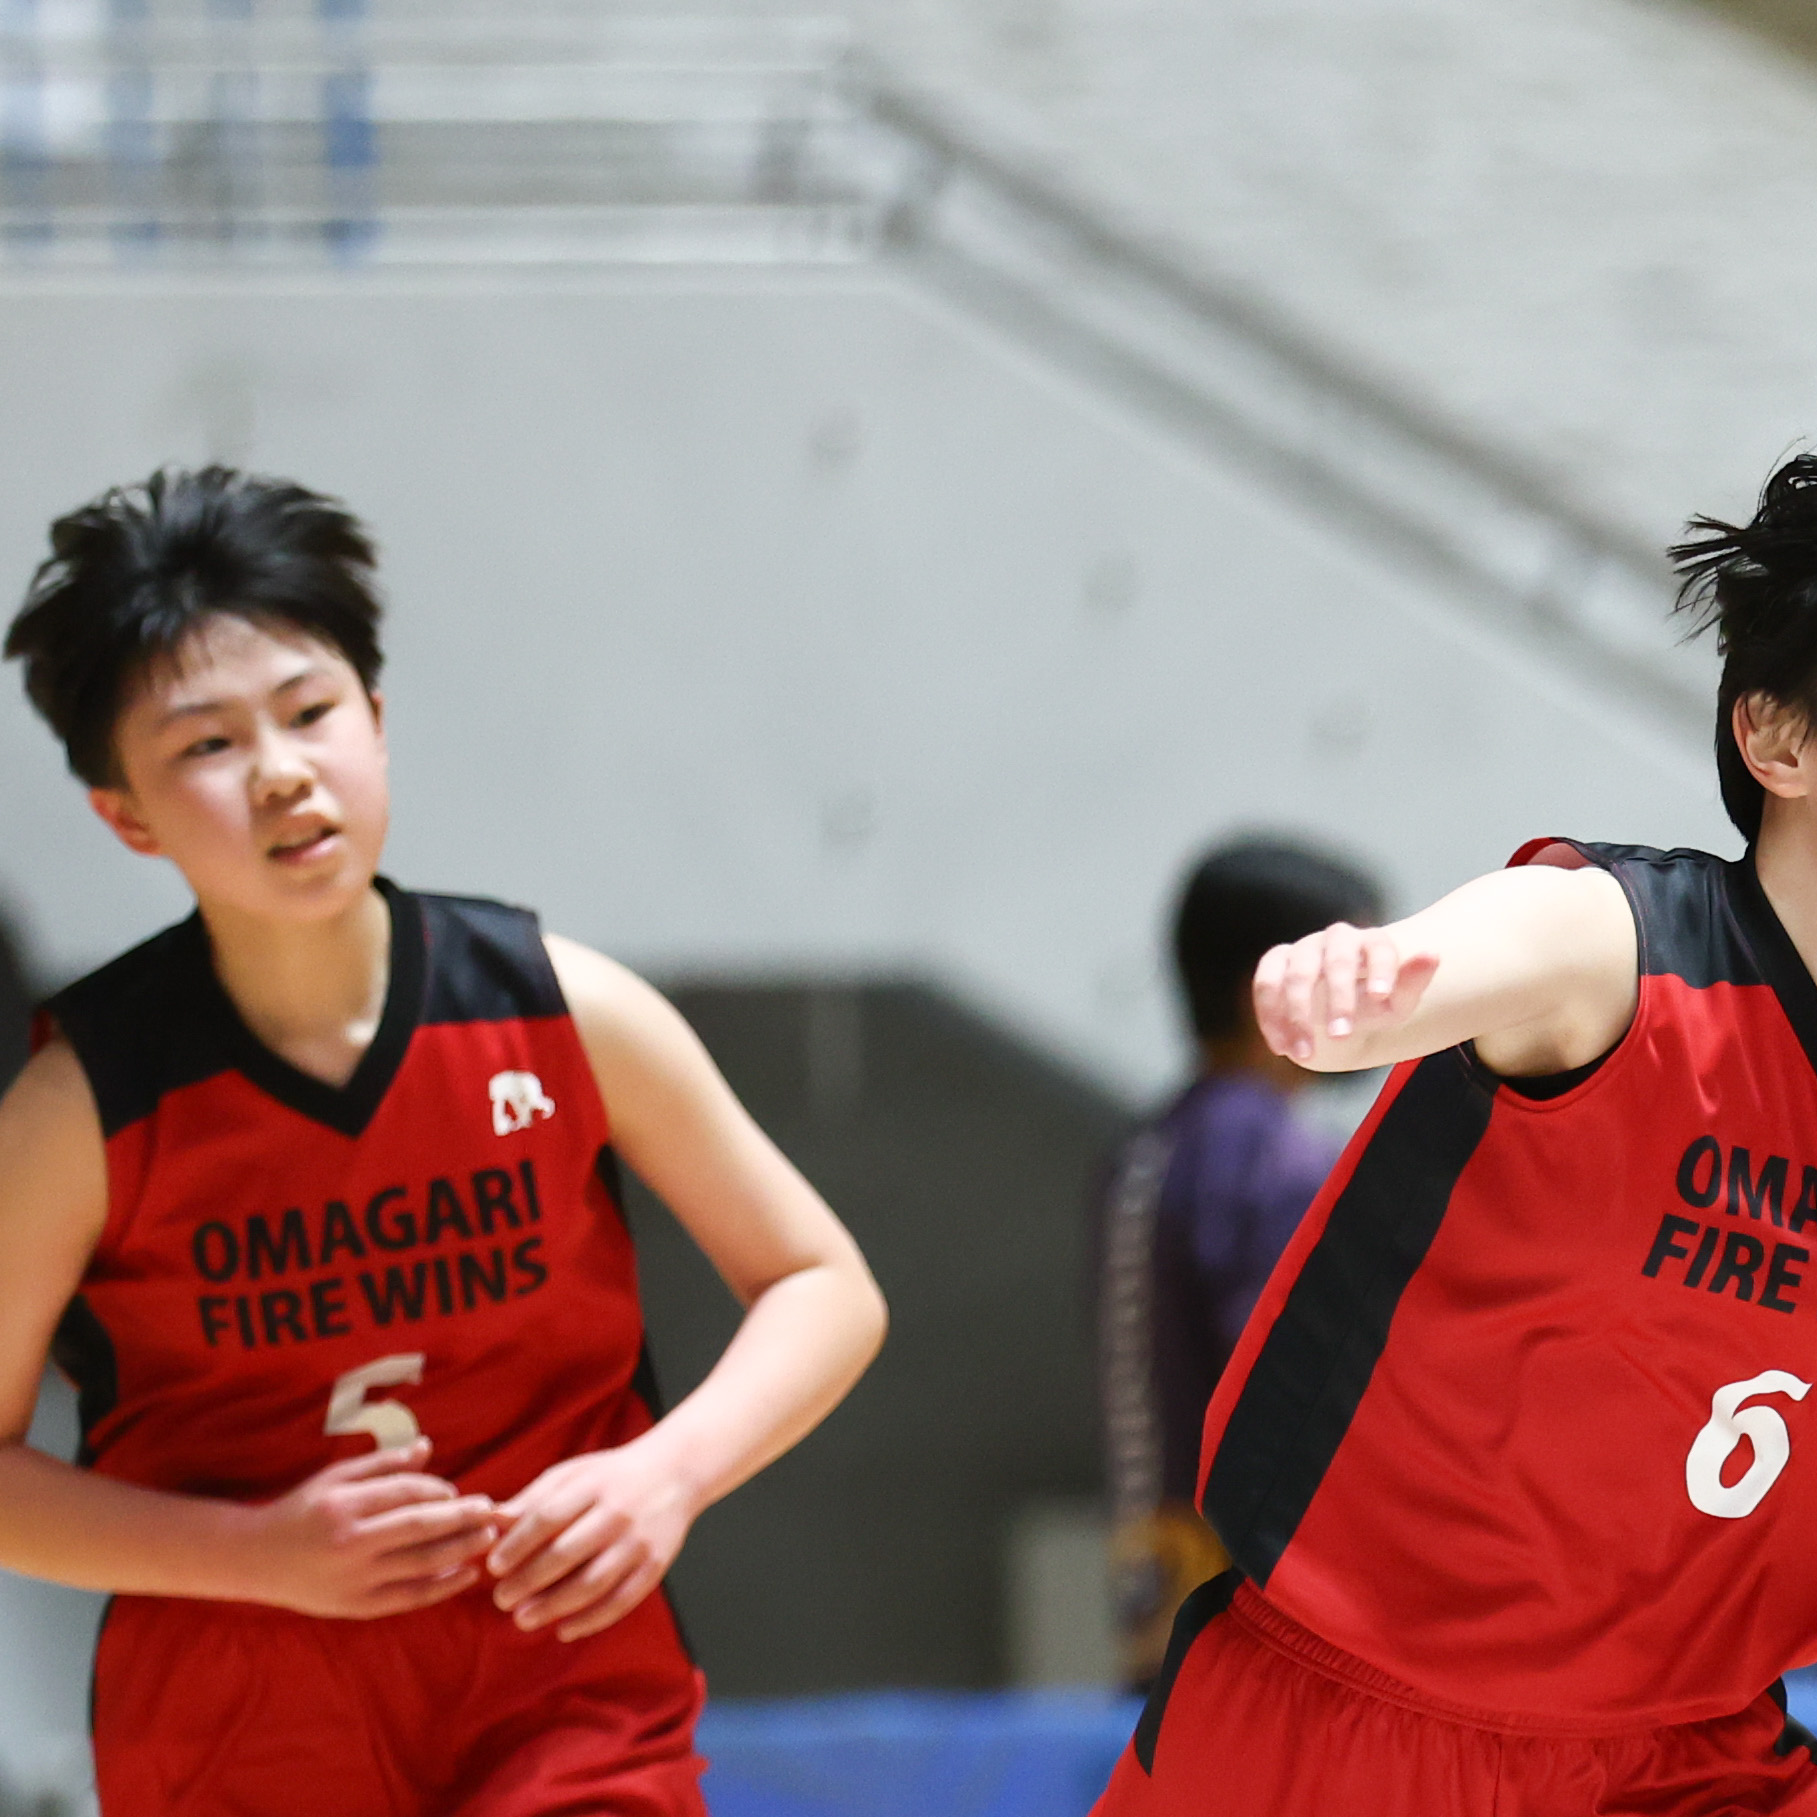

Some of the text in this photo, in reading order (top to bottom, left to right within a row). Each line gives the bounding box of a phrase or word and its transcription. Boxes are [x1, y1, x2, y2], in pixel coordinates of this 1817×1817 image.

[190, 1160, 542, 1284] OMAGARI
[1640, 1212, 1810, 1314] FIRE
[196, 1236, 549, 1349] FIRE WINS
[322, 1352, 427, 1461] 5
[1685, 1369, 1813, 1519] 6
